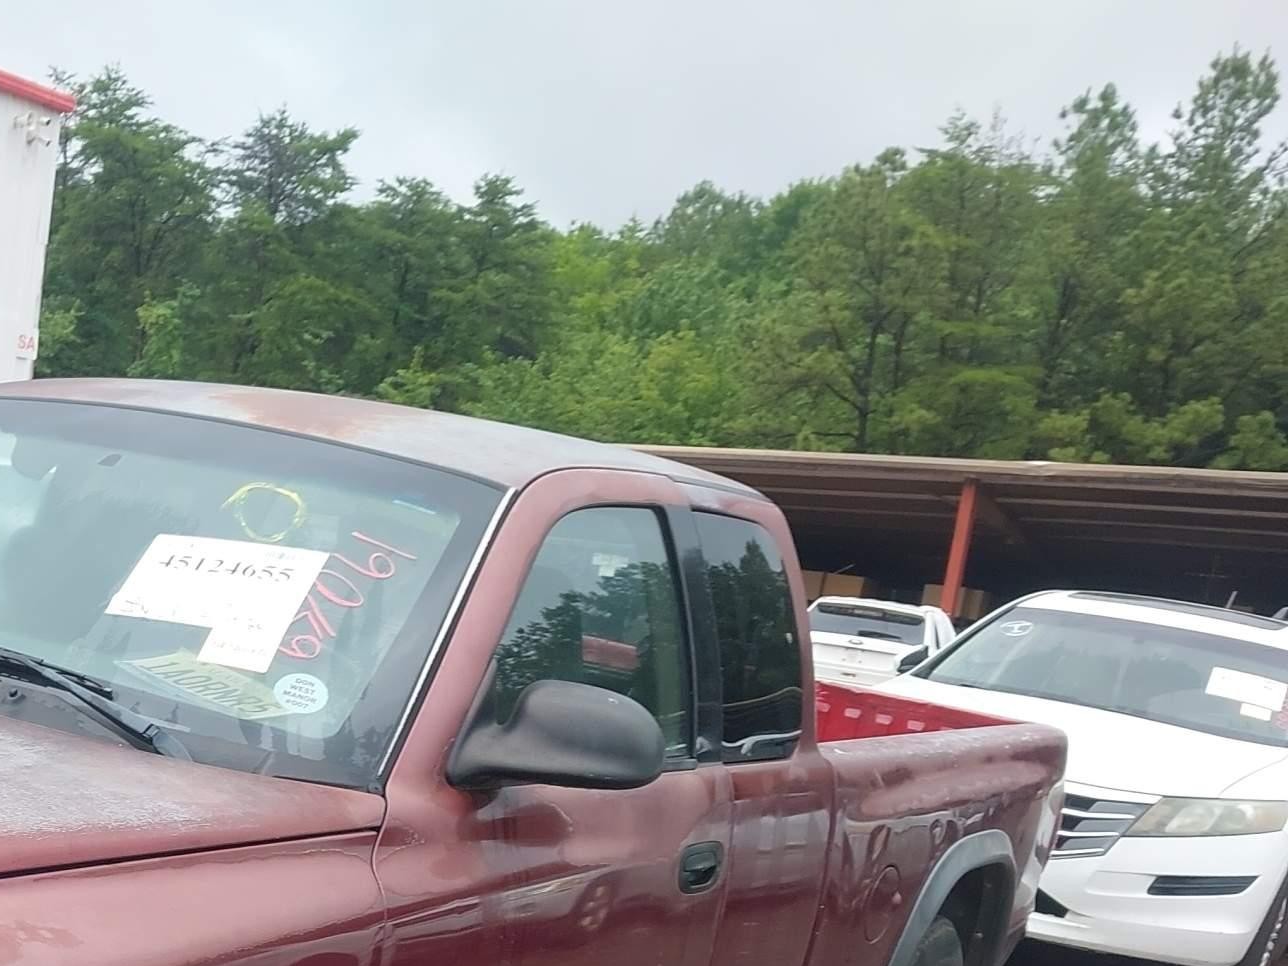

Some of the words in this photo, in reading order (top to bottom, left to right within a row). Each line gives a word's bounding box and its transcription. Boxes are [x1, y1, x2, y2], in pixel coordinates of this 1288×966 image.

[17, 334, 35, 350] SA
[159, 553, 295, 583] 45124655
[290, 684, 317, 696] WEST
